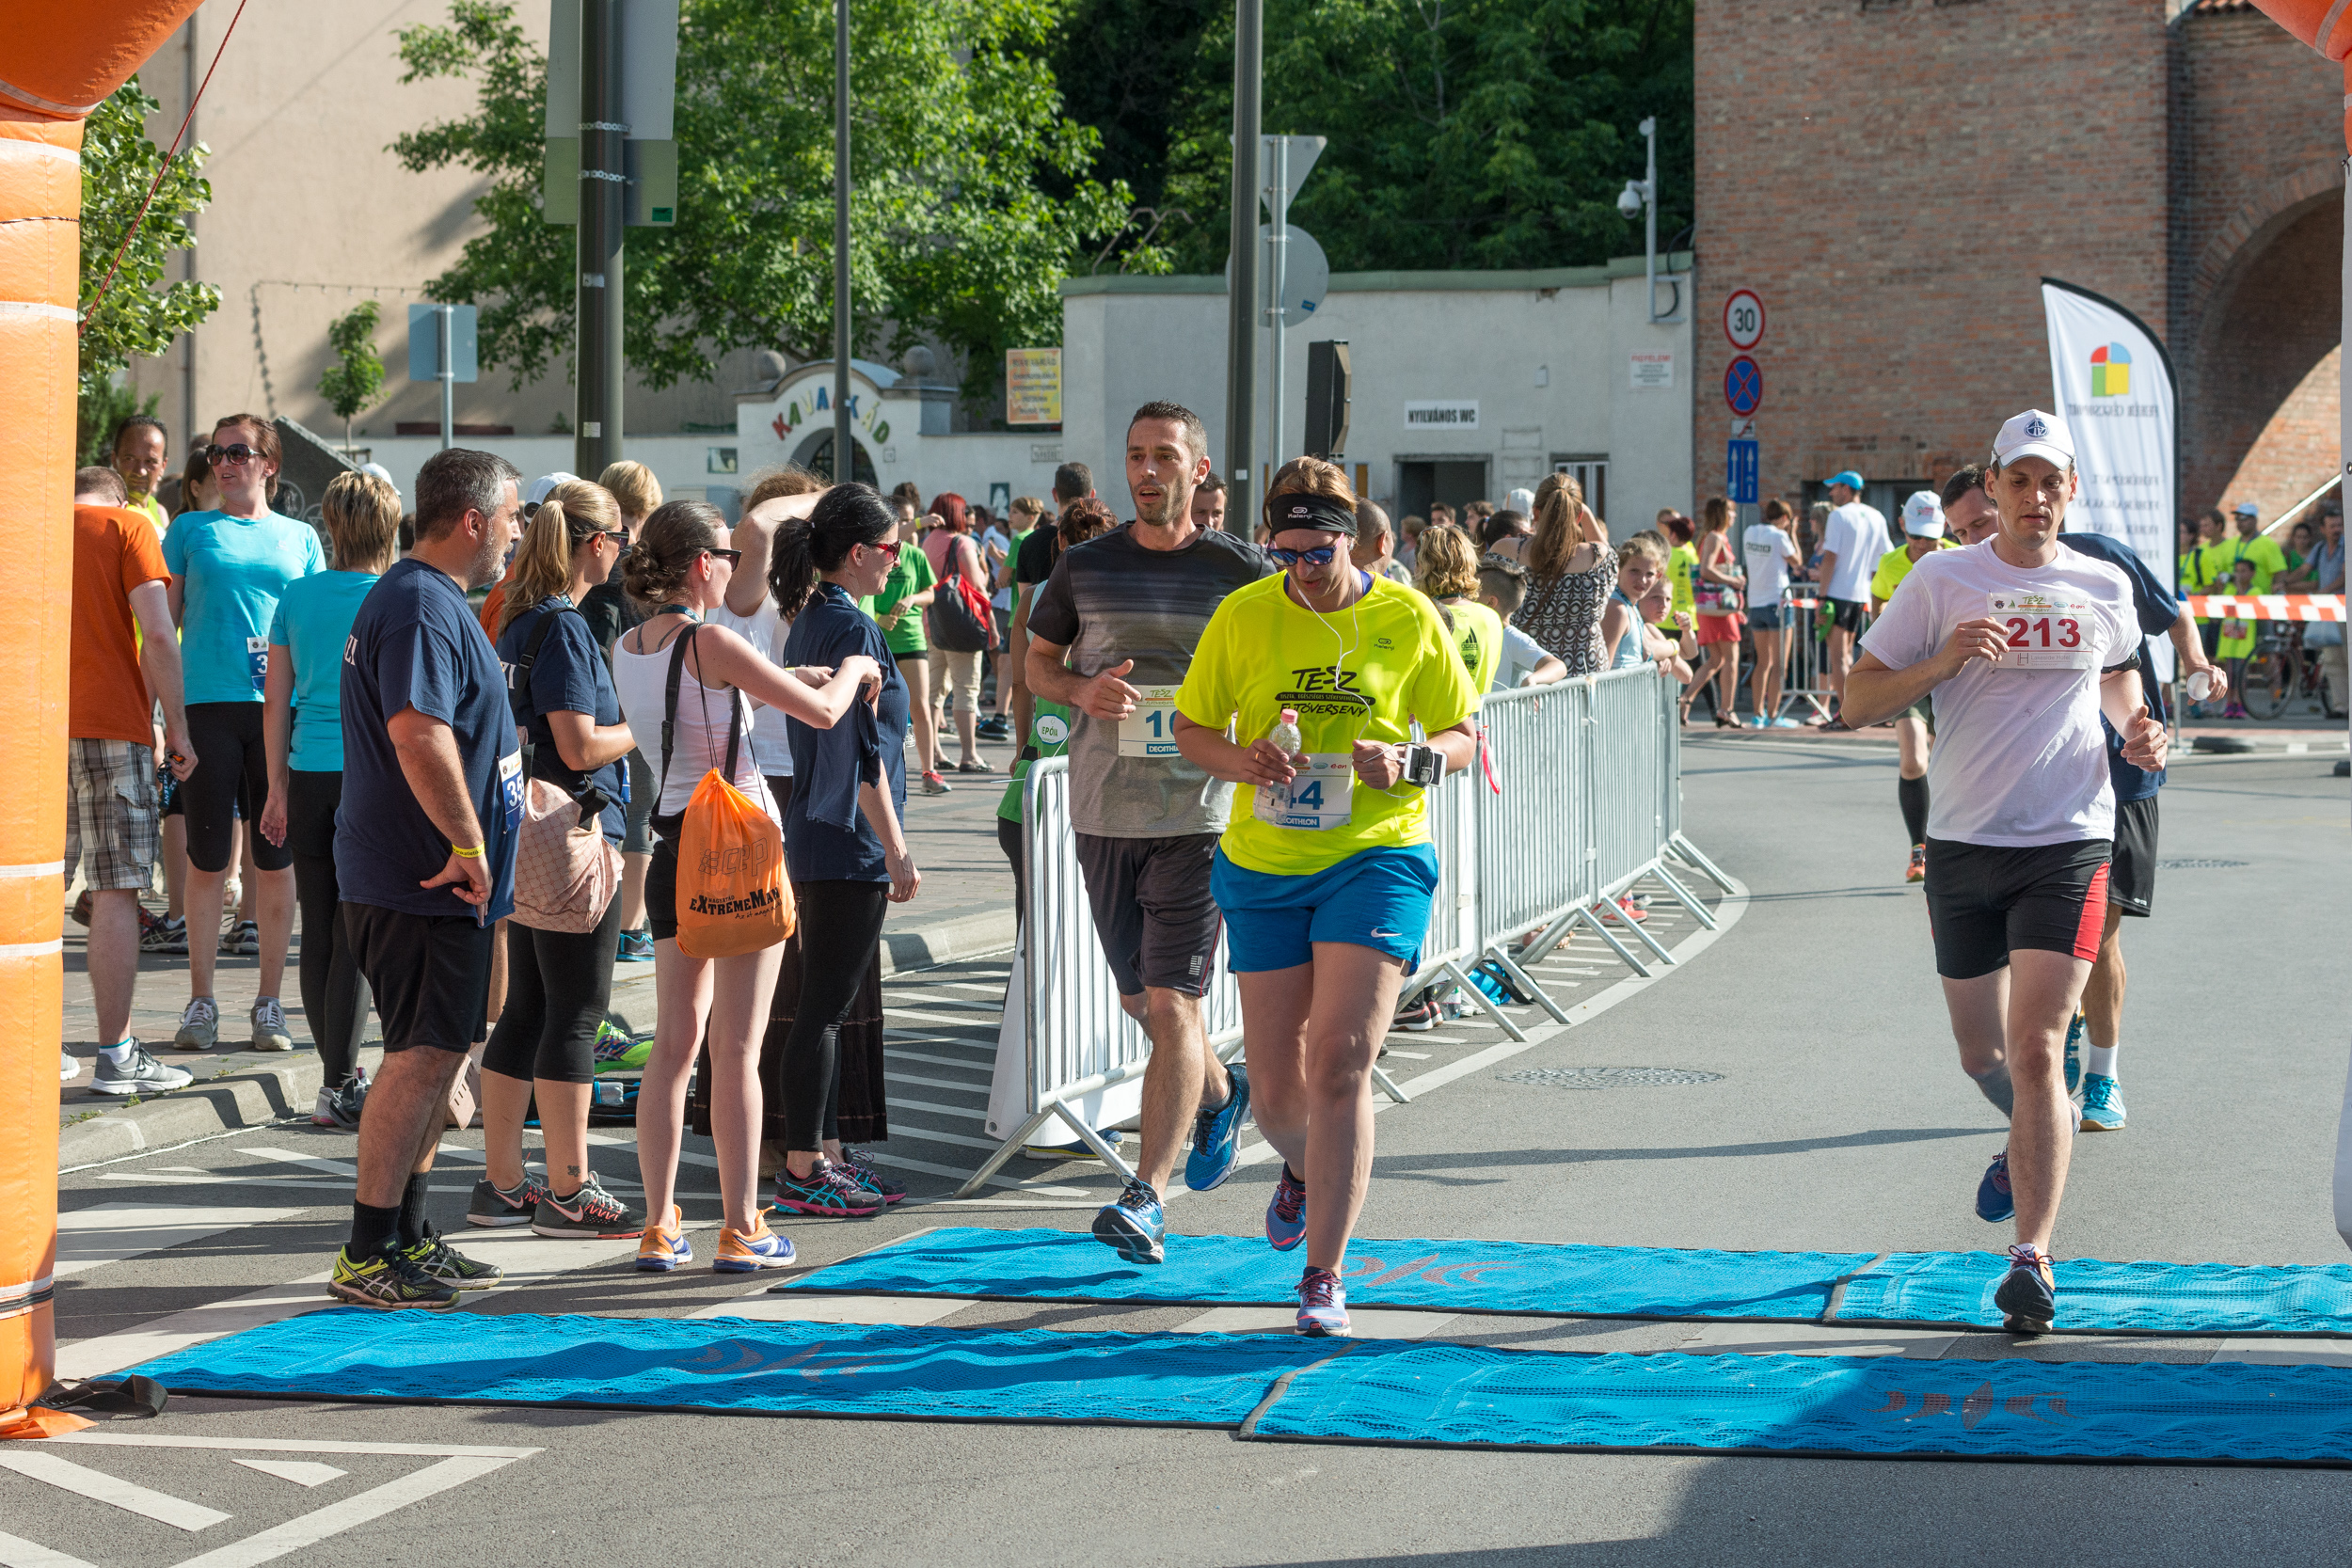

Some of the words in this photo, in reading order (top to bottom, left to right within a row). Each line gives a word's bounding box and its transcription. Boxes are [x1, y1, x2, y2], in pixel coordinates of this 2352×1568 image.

[1734, 308, 1755, 332] 30
[771, 387, 890, 445] KAVAKÁD
[1408, 406, 1457, 423] NYILVÁNOS
[1459, 408, 1475, 423] WC
[2022, 595, 2046, 605] TESZ
[2006, 617, 2081, 648] 213
[1292, 665, 1360, 692] TESZ
[1150, 689, 1172, 698] TESZ
[507, 774, 525, 807] 35
